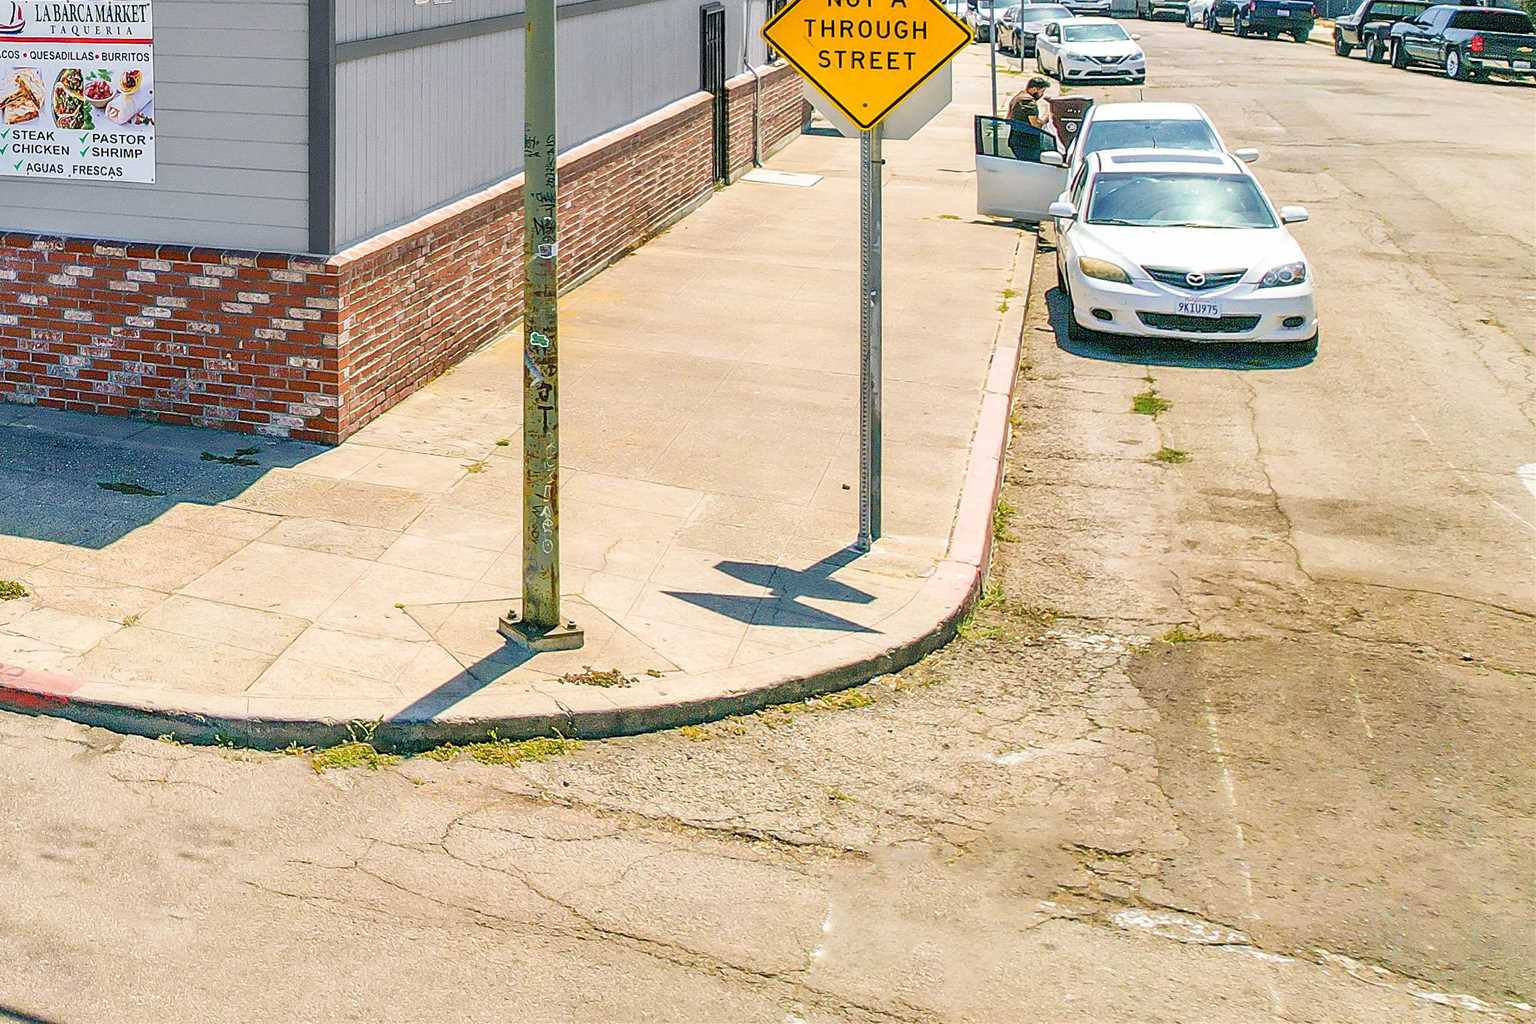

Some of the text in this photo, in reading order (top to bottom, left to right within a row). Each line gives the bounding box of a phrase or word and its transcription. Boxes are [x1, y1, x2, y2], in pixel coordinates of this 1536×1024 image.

[35, 4, 147, 23] LA BARCA MARKET
[50, 25, 133, 36] TAQUERIA
[804, 19, 927, 40] THROUGH
[29, 50, 95, 61] QUESADILLAS
[101, 52, 150, 62] BURRITOS
[818, 50, 916, 70] STREET
[12, 129, 55, 141] STEAK
[92, 133, 146, 145] PASTOR
[12, 143, 70, 156] CHICKEN
[92, 147, 143, 159] SHRIMP
[26, 162, 123, 176] AGUAS FRESCAS
[1178, 302, 1218, 315] 9KIU975
